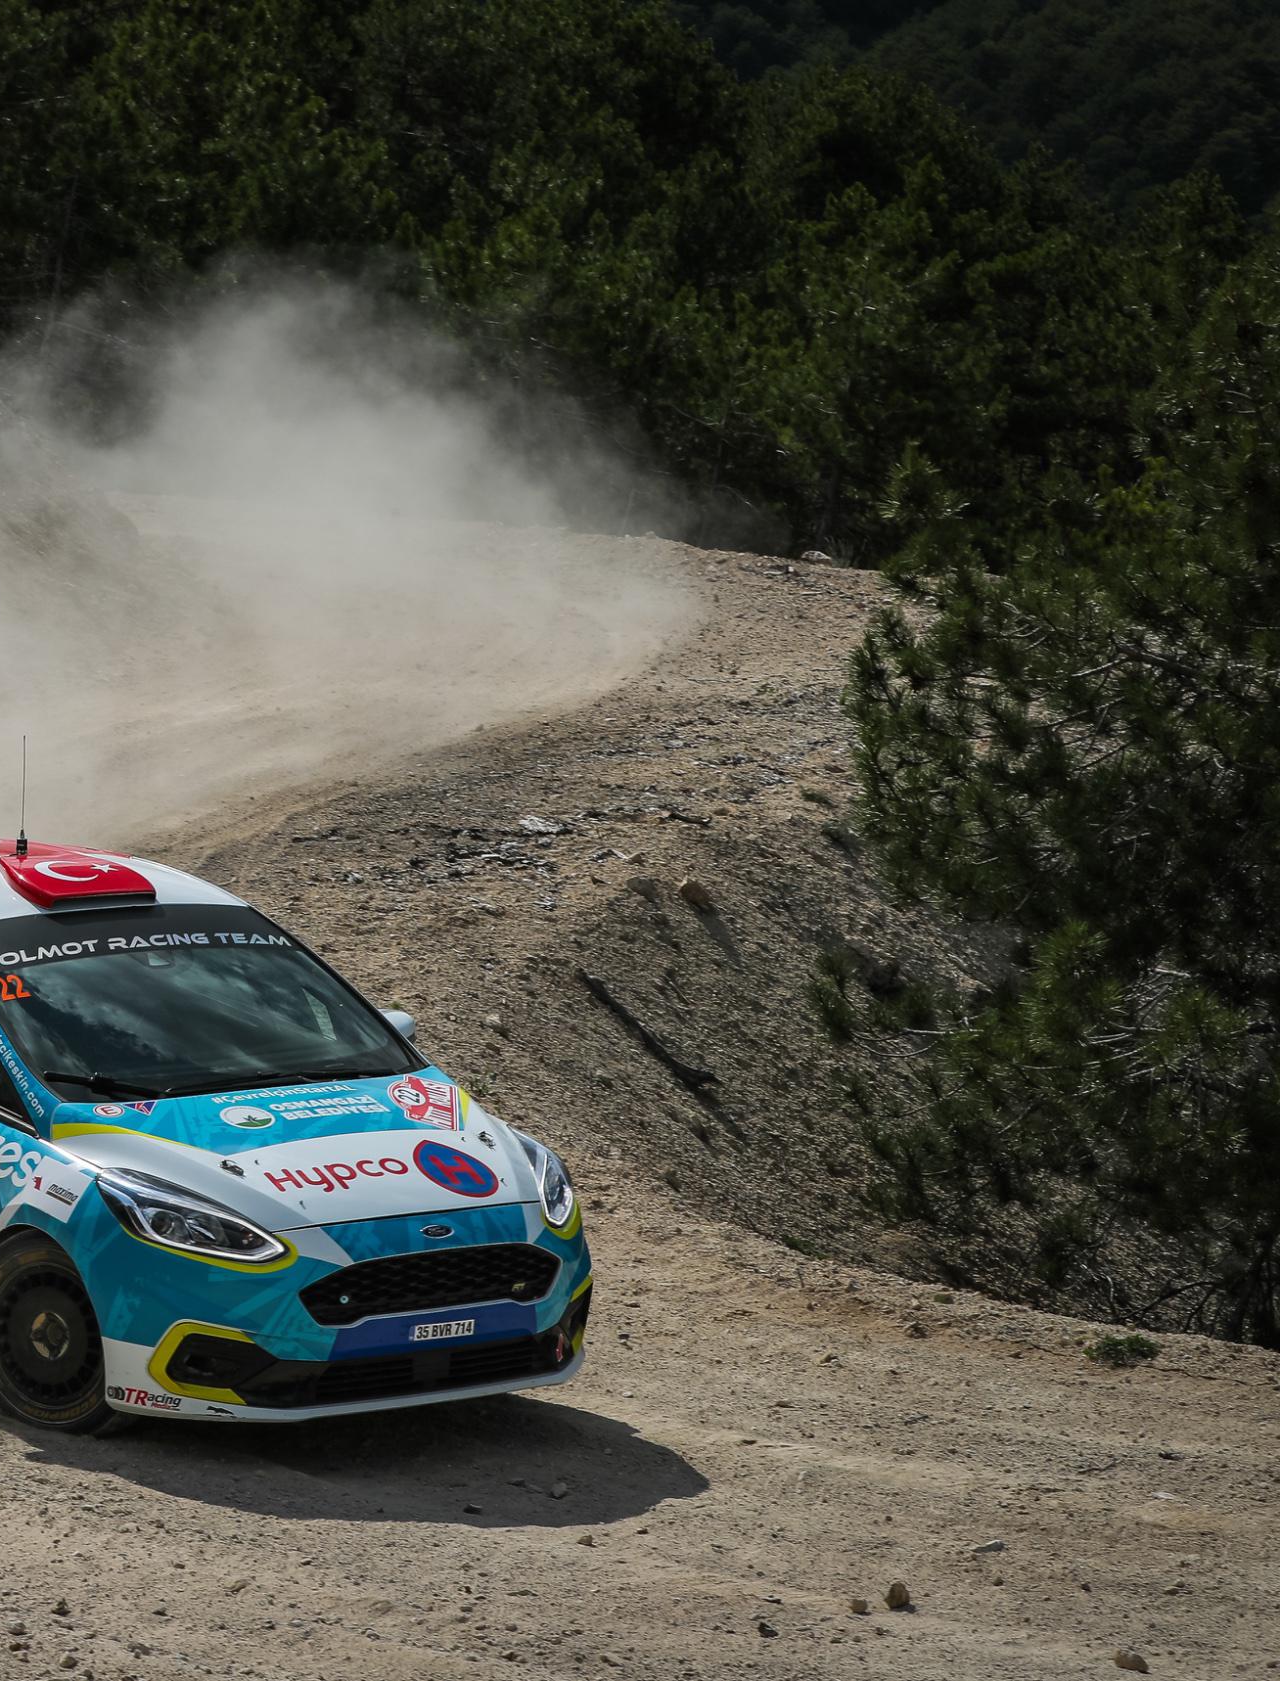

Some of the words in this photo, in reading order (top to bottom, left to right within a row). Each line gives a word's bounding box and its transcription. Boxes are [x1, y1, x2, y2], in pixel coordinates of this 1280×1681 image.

[107, 932, 210, 949] RACING
[214, 932, 292, 947] TEAM
[397, 1089, 420, 1104] 22
[263, 1157, 409, 1193] Hypco
[416, 1326, 429, 1339] 35
[431, 1323, 452, 1337] BVR
[455, 1321, 473, 1335] 714
